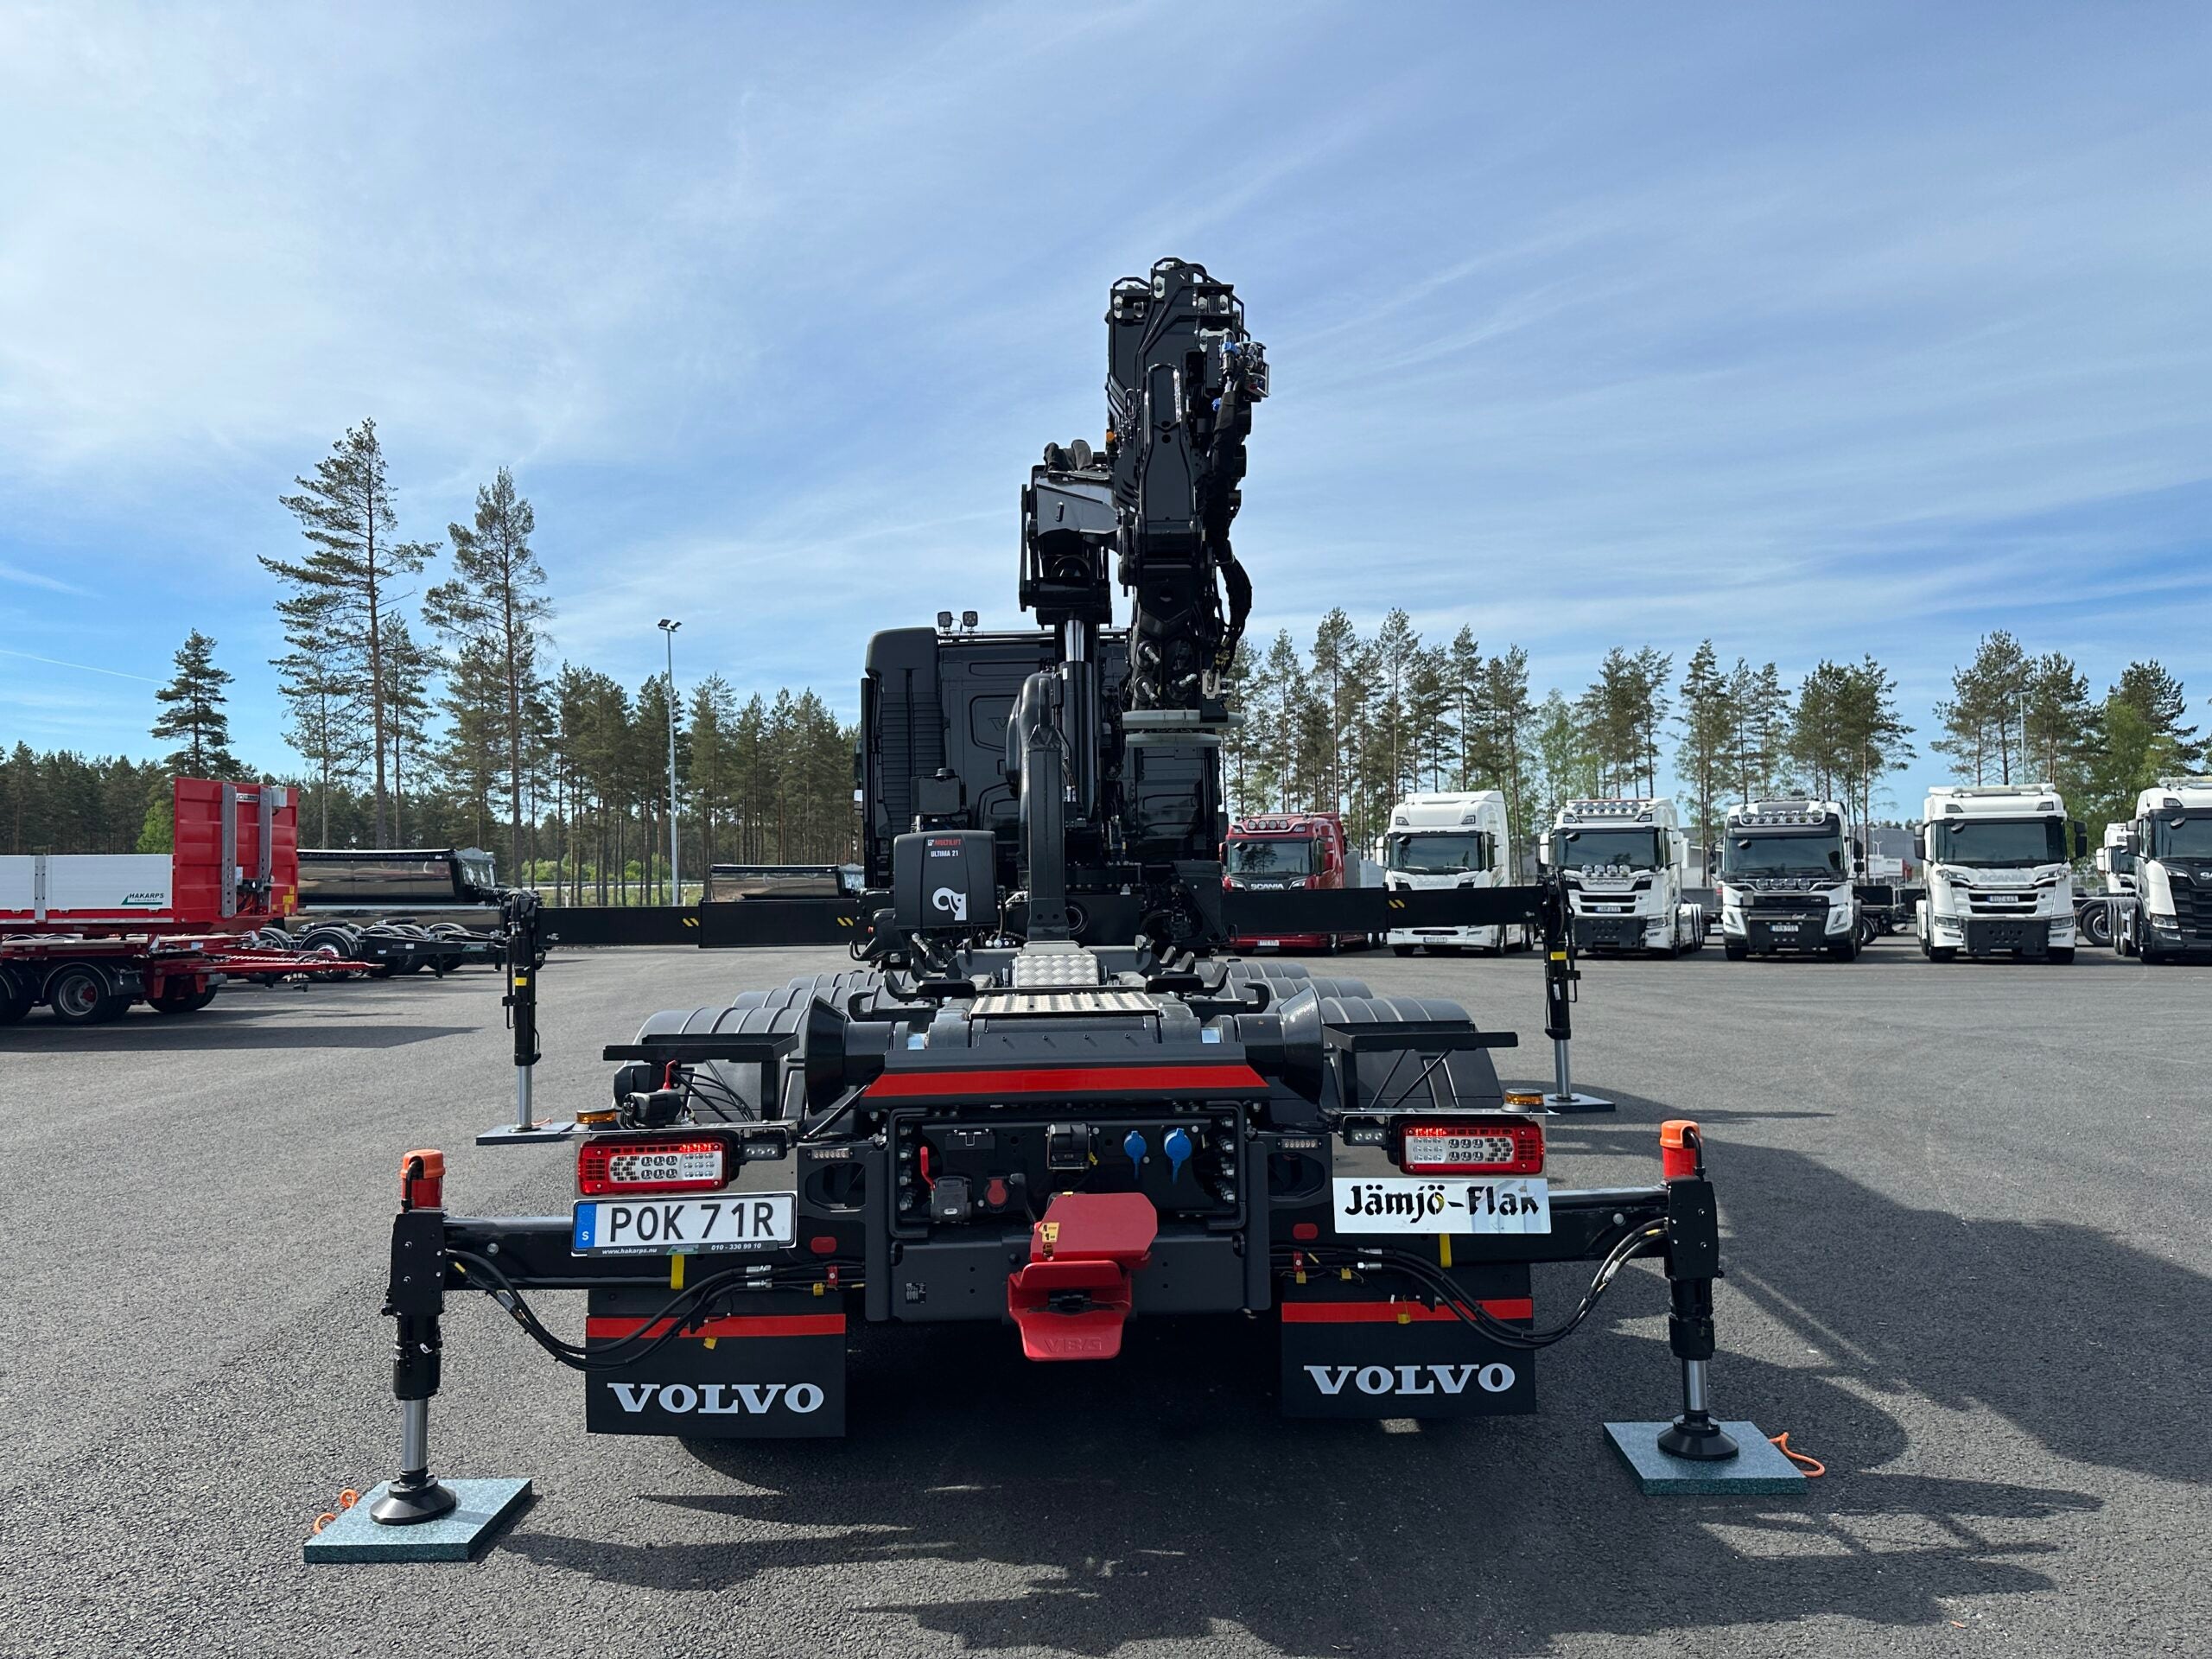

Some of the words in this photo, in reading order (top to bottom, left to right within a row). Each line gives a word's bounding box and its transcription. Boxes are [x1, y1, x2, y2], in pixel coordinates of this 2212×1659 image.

[1979, 874, 2027, 882] SCANIA
[610, 1205, 685, 1243] POK
[700, 1202, 774, 1239] 71R
[582, 1230, 589, 1241] S
[1044, 1337, 1102, 1353] VBG
[1304, 1363, 1515, 1395] VOLVO
[607, 1382, 824, 1414] VOLVO
